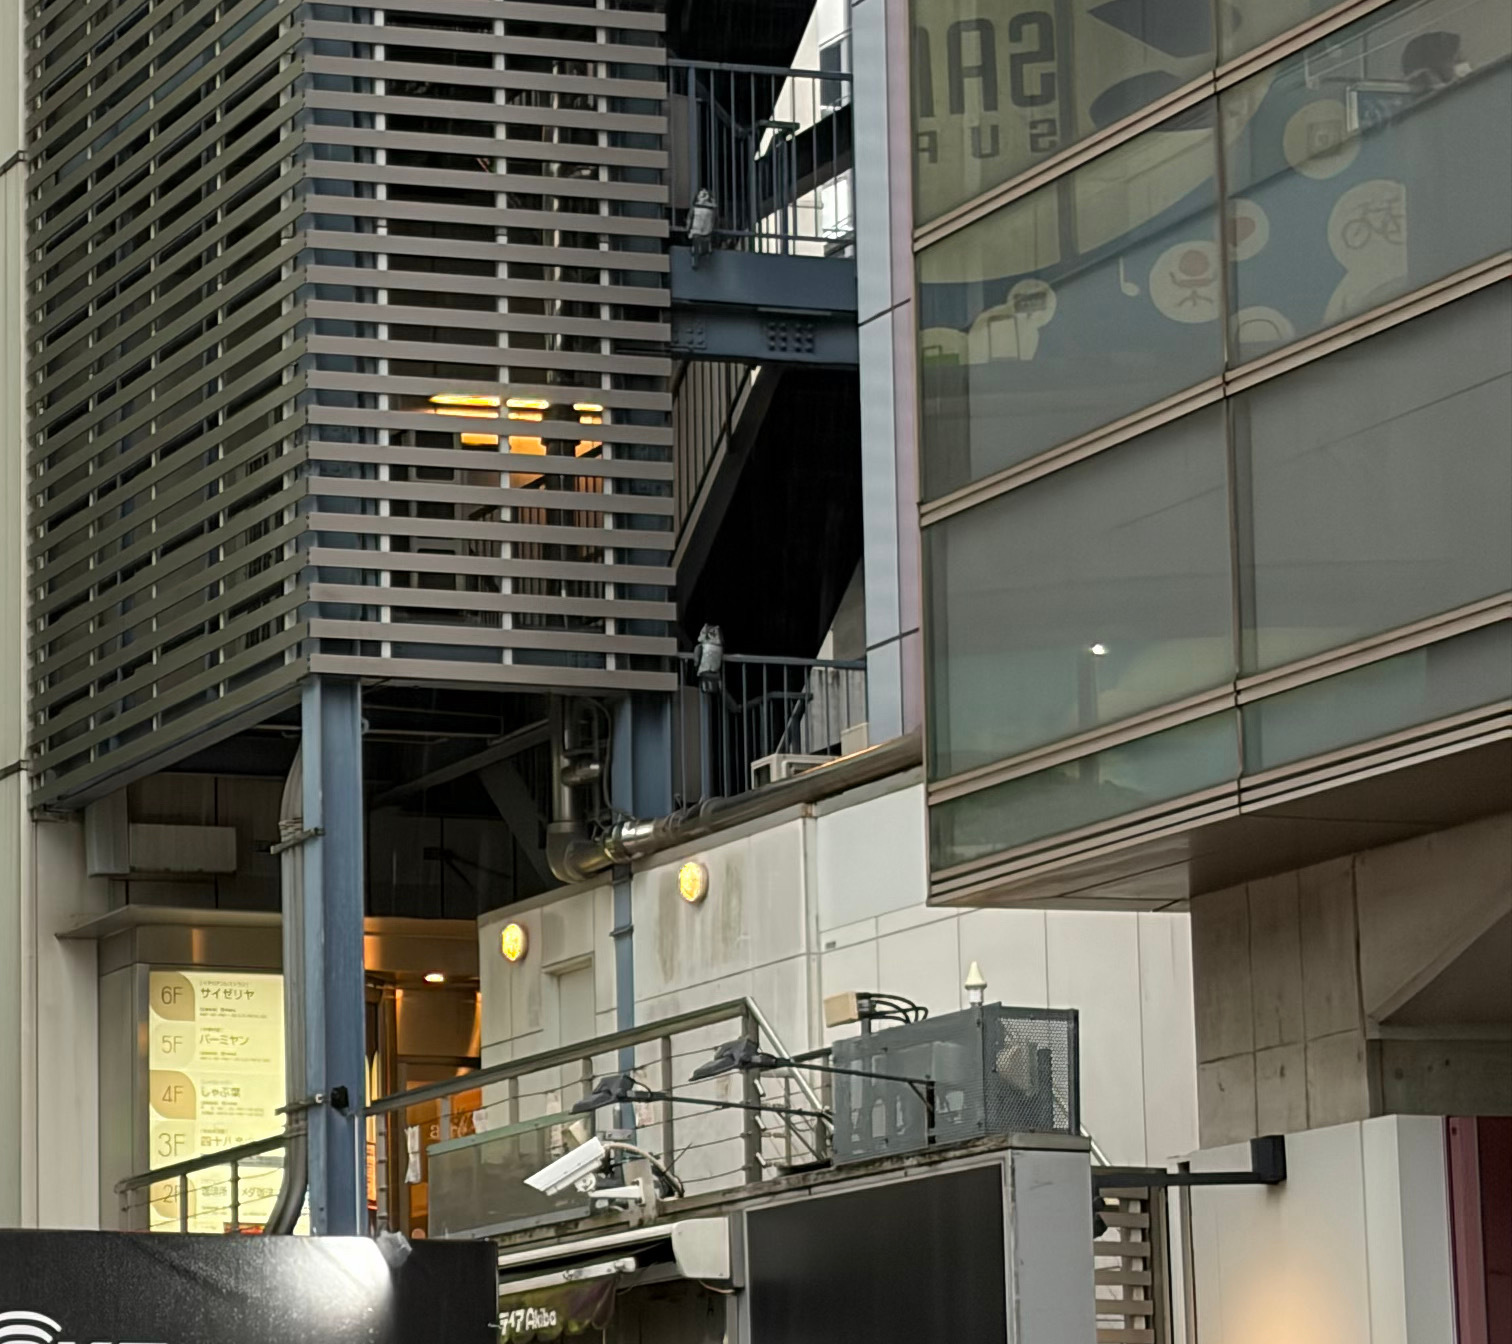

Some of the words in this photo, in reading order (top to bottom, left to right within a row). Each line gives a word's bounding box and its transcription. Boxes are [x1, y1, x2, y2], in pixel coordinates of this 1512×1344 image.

[161, 985, 184, 1005] 6F
[200, 987, 255, 1001] サイゼリヤ
[161, 1035, 183, 1054] 5F
[199, 1034, 250, 1047] バーミヤン
[161, 1085, 184, 1103] 4F
[158, 1132, 186, 1157] 3F
